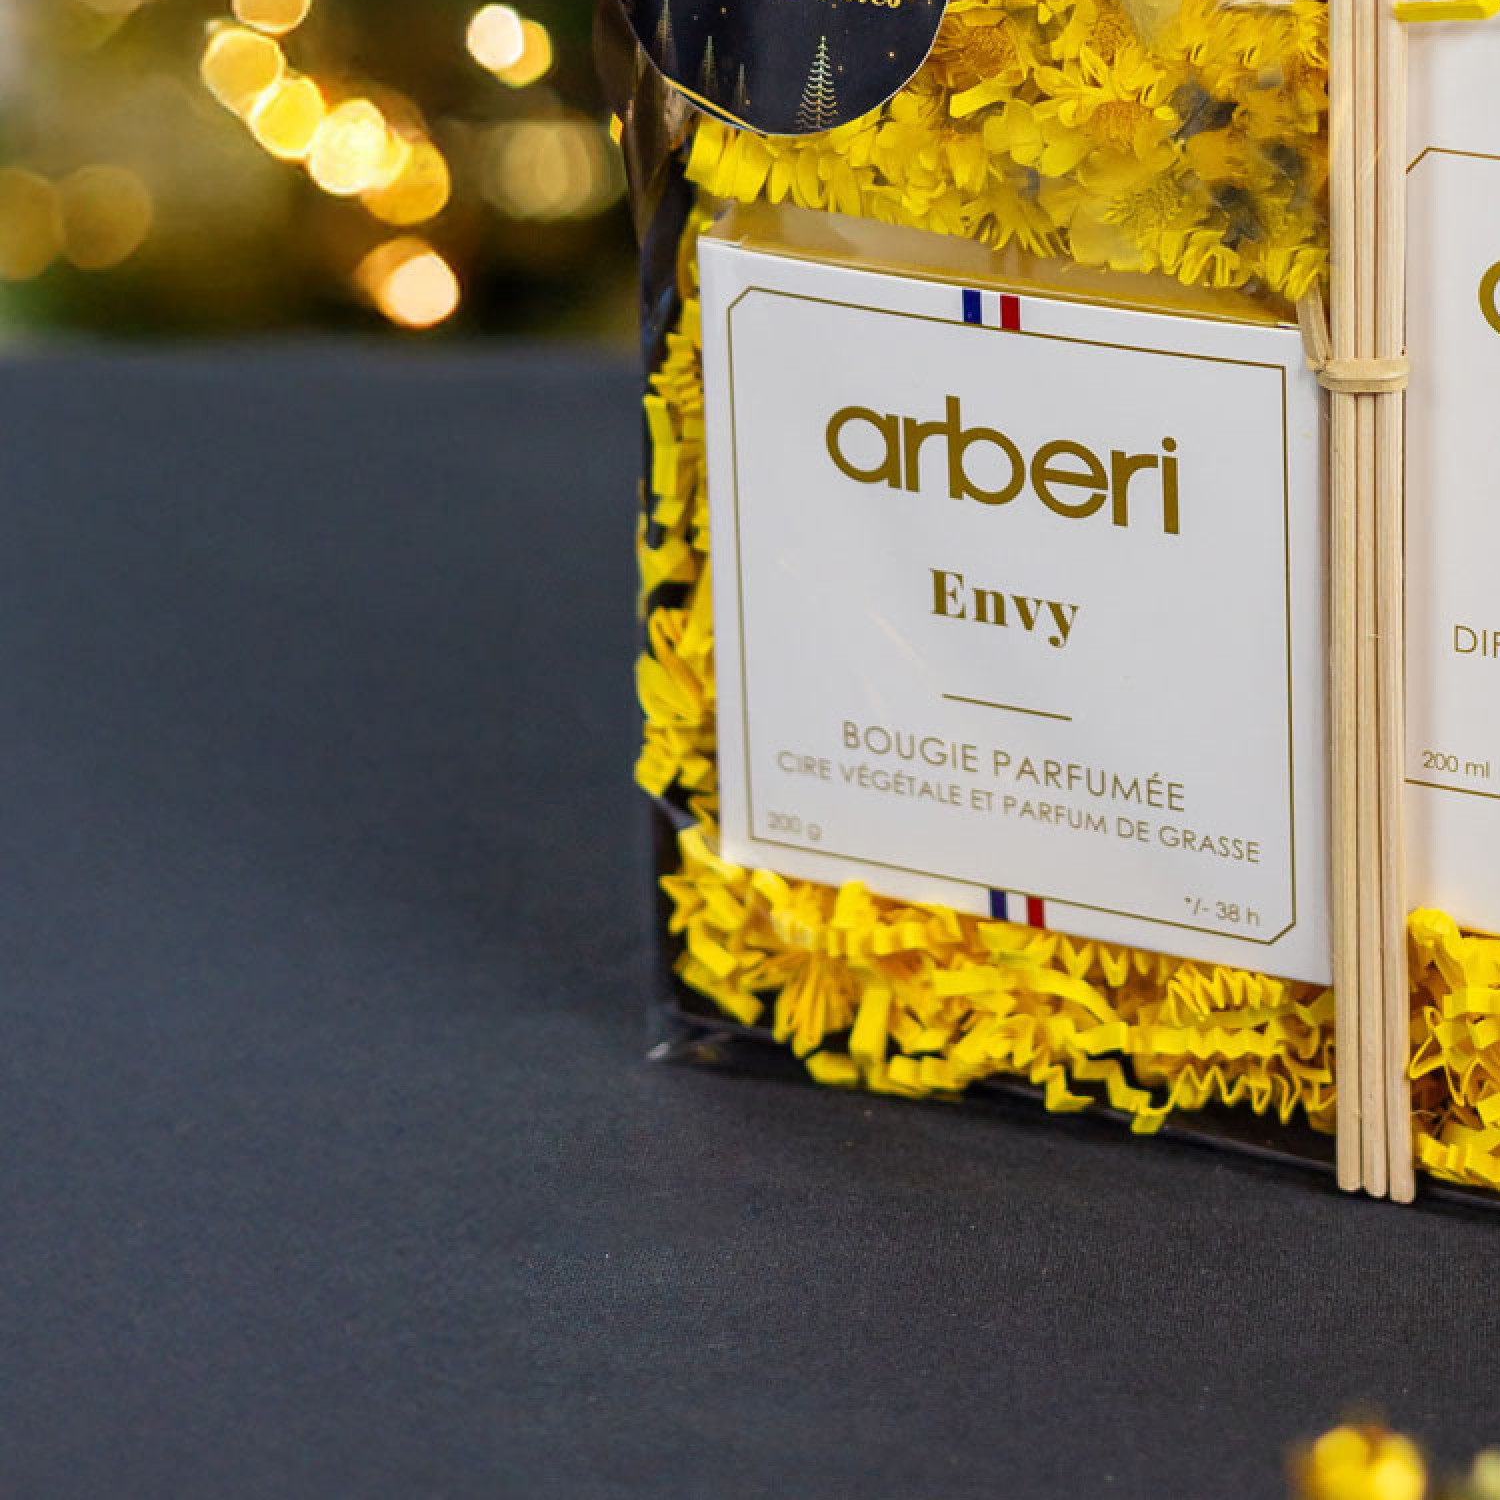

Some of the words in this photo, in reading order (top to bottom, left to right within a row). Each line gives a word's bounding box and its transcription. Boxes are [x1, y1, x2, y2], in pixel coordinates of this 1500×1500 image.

[825, 395, 1180, 535] arberi
[929, 568, 1079, 648] Envy
[842, 720, 978, 773] BOUGIE
[993, 749, 1185, 812] PARFUMÉE
[1423, 749, 1459, 773] 200
[1465, 759, 1490, 779] ml
[777, 751, 832, 780] CIRE
[839, 760, 962, 806] VÉGÉTALE
[970, 788, 993, 812] ET
[1003, 795, 1107, 835] PARFUM
[1117, 817, 1149, 843] DE
[1158, 825, 1260, 864] GRASSE
[1216, 901, 1240, 922] 38
[1247, 907, 1260, 927] h
